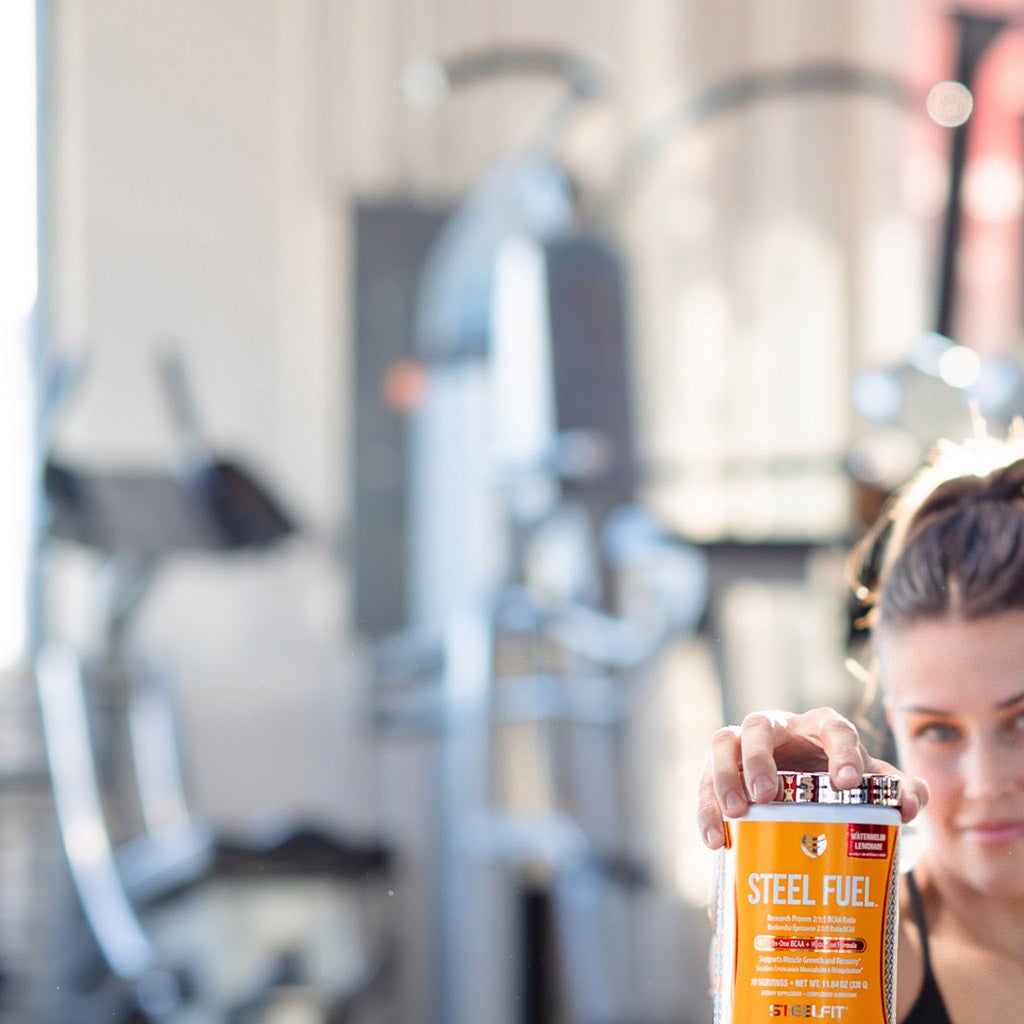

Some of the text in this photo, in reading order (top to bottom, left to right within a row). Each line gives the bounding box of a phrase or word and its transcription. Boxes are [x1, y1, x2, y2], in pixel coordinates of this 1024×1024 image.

[854, 842, 883, 850] LEMONADE
[747, 872, 875, 907] STEEL FUEL
[767, 914, 791, 922] Research
[792, 915, 812, 923] Proven
[790, 939, 804, 947] BCAA
[758, 978, 788, 986] SERVINGS
[795, 979, 808, 987] NET
[840, 980, 848, 988] OZ
